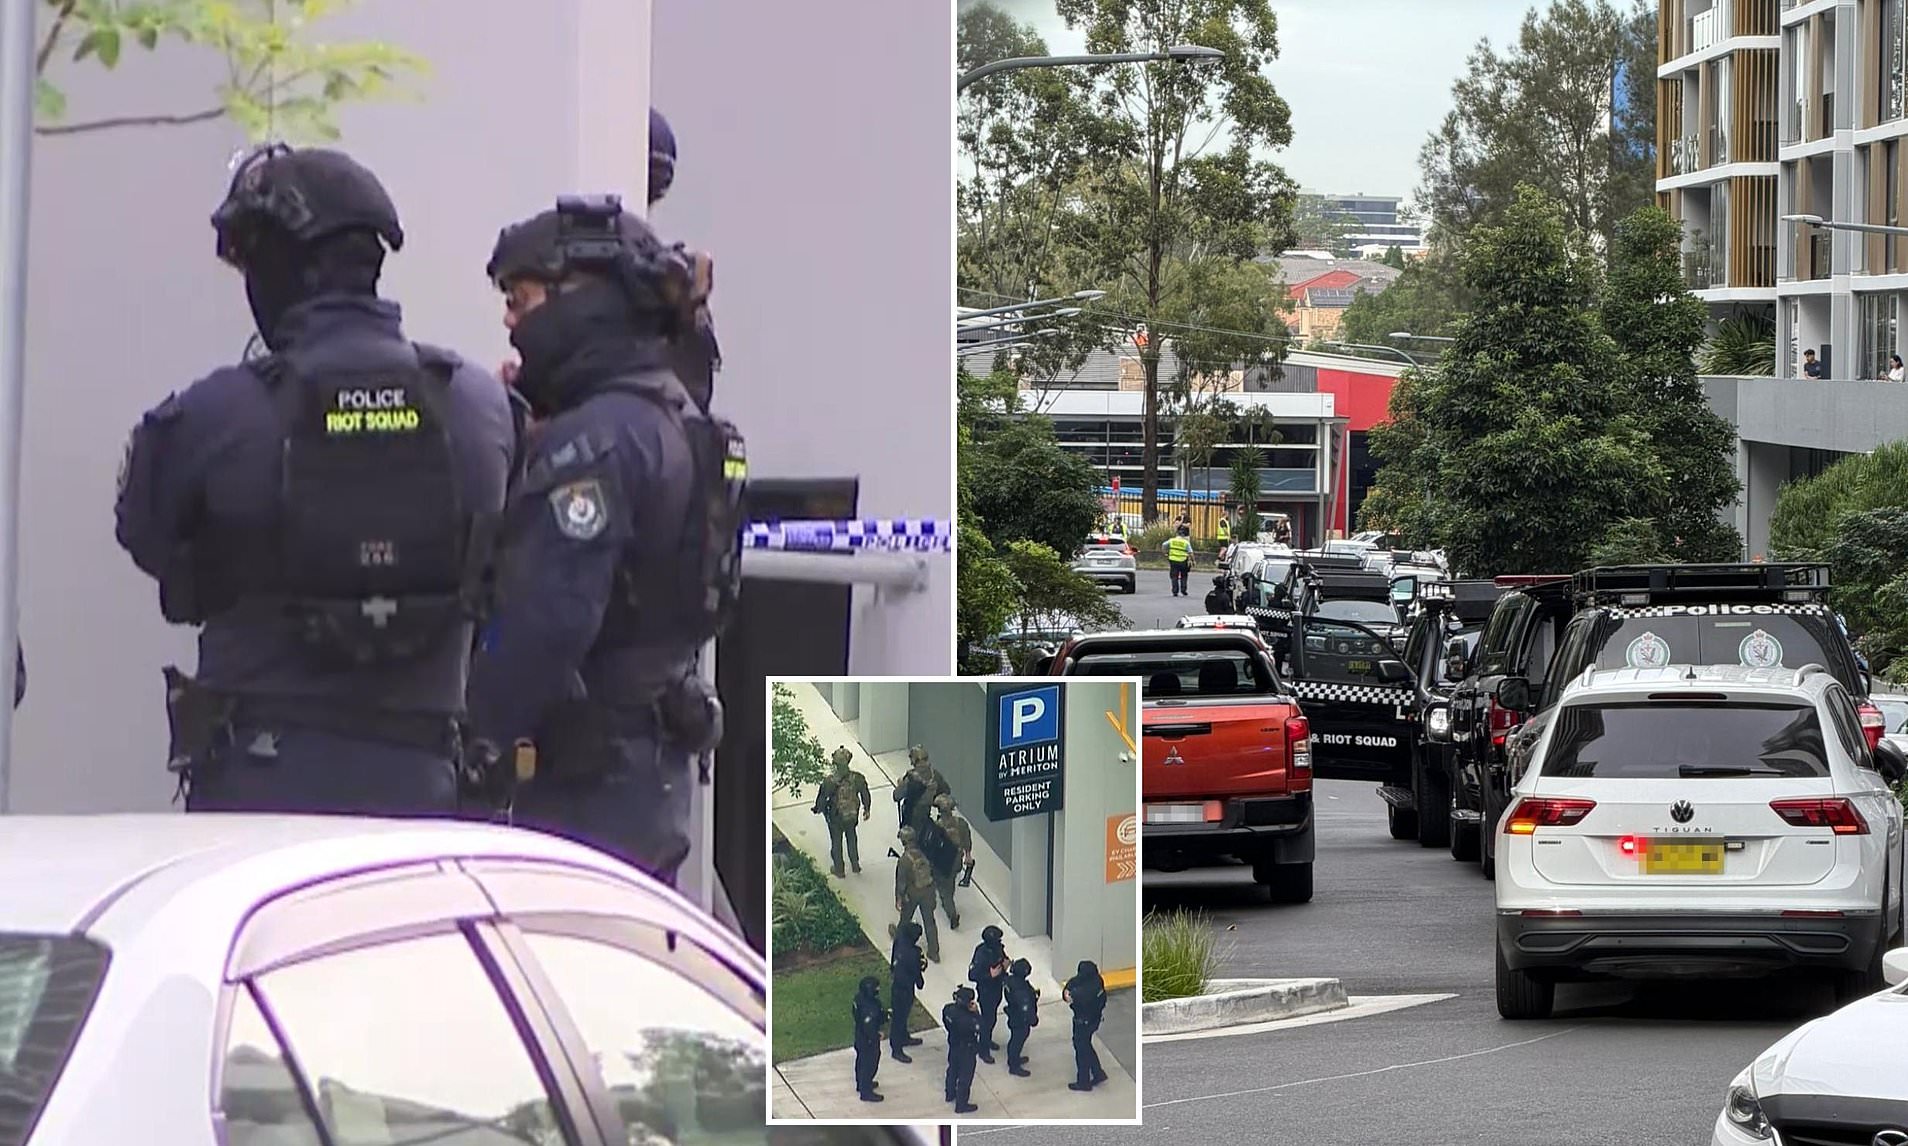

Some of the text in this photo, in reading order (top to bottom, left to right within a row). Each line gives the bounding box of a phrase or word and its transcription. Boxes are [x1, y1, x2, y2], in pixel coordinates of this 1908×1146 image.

[338, 388, 406, 409] POLICE
[326, 409, 419, 433] RIOT SQUAD
[1664, 603, 1774, 616] Police
[1012, 697, 1045, 739] P
[1311, 733, 1397, 748] & RIOT SQUAD
[999, 744, 1058, 770] ATRIUM
[998, 761, 1058, 780] BY MERITON
[1004, 780, 1051, 797] RESIDENT
[1006, 790, 1050, 806] PARKING
[1013, 800, 1041, 813] ONLY
